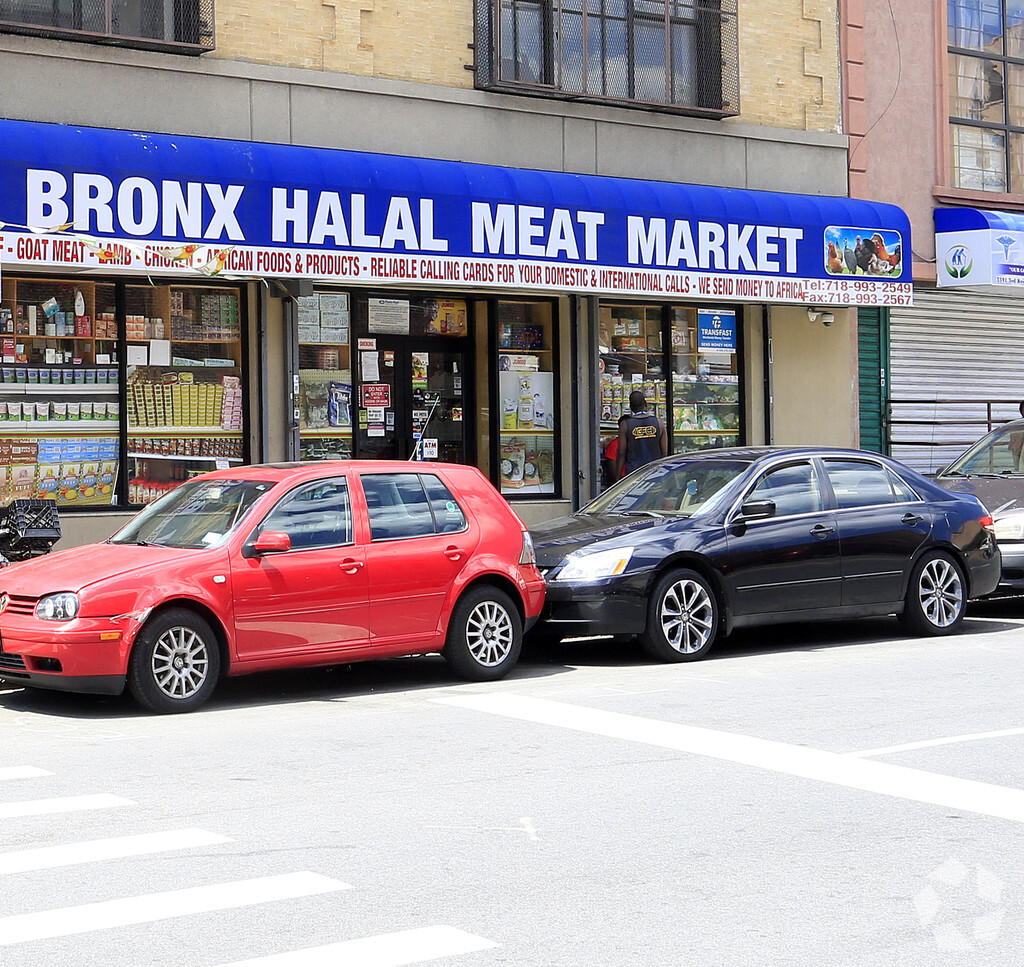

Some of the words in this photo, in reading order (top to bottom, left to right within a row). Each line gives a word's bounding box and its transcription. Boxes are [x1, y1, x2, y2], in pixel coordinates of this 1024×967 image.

[26, 168, 246, 242] BRONX
[272, 187, 449, 252] HALAL
[471, 201, 605, 261] MEAT
[627, 215, 804, 274] MARKET
[17, 237, 49, 261] GOAT
[52, 240, 86, 264] MEAT
[98, 242, 132, 266] LAMB
[257, 251, 292, 274] FOODS
[295, 255, 303, 274] &
[306, 254, 360, 277] PRODUCTS
[370, 257, 417, 279] RELIABLE
[420, 260, 460, 281] CALLING
[463, 262, 494, 282] CARDS
[497, 264, 515, 283] FOR
[518, 264, 543, 285] YOUR
[545, 266, 589, 288] DOMESTIC
[590, 271, 598, 288] &
[599, 271, 663, 293] INTERNATIONAL
[665, 275, 690, 294] CALLS
[698, 277, 711, 295] WE
[713, 278, 734, 296] SEND
[736, 279, 763, 297] MONEY
[765, 280, 775, 298] TO
[776, 281, 803, 300] AFRICA
[802, 279, 911, 294] Tel:718-993-2549
[801, 291, 912, 306] Fax:718-993-2567
[700, 328, 733, 337] TRANSFAST
